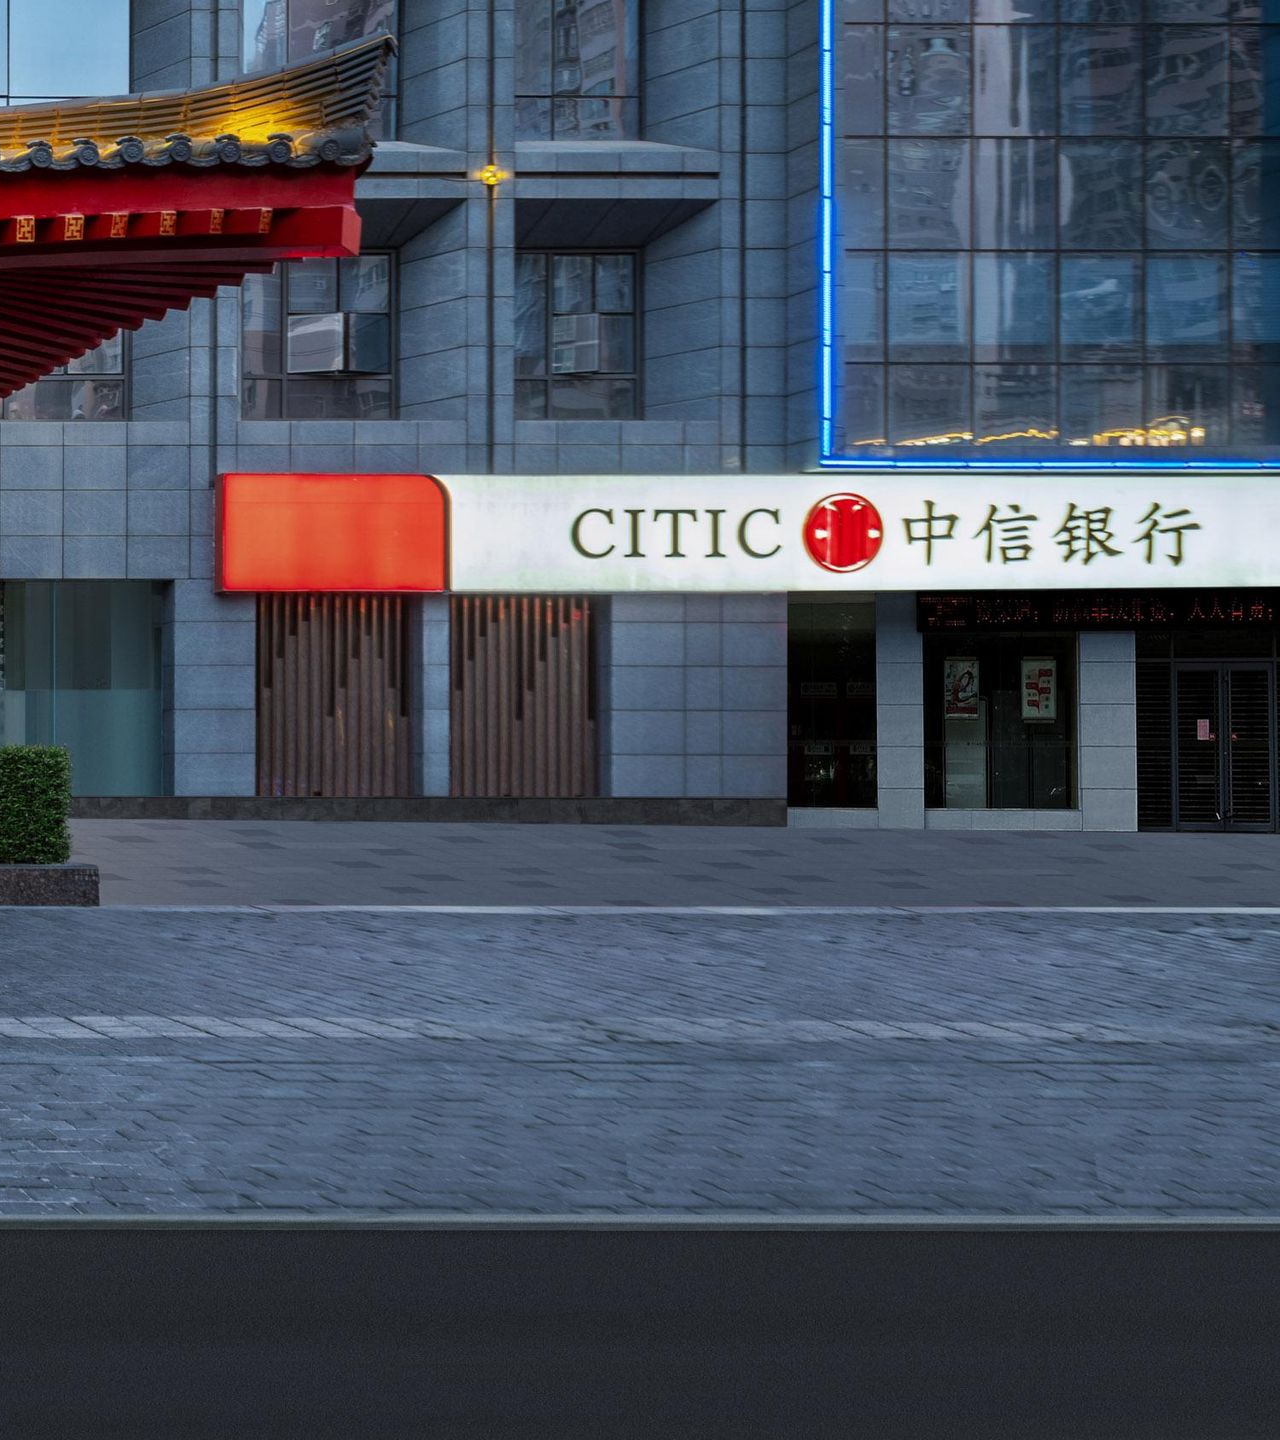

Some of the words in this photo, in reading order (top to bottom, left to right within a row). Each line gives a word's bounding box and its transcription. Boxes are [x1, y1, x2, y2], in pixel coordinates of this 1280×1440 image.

[571, 509, 781, 558] CITIC
[903, 500, 1200, 566] 中信银行
